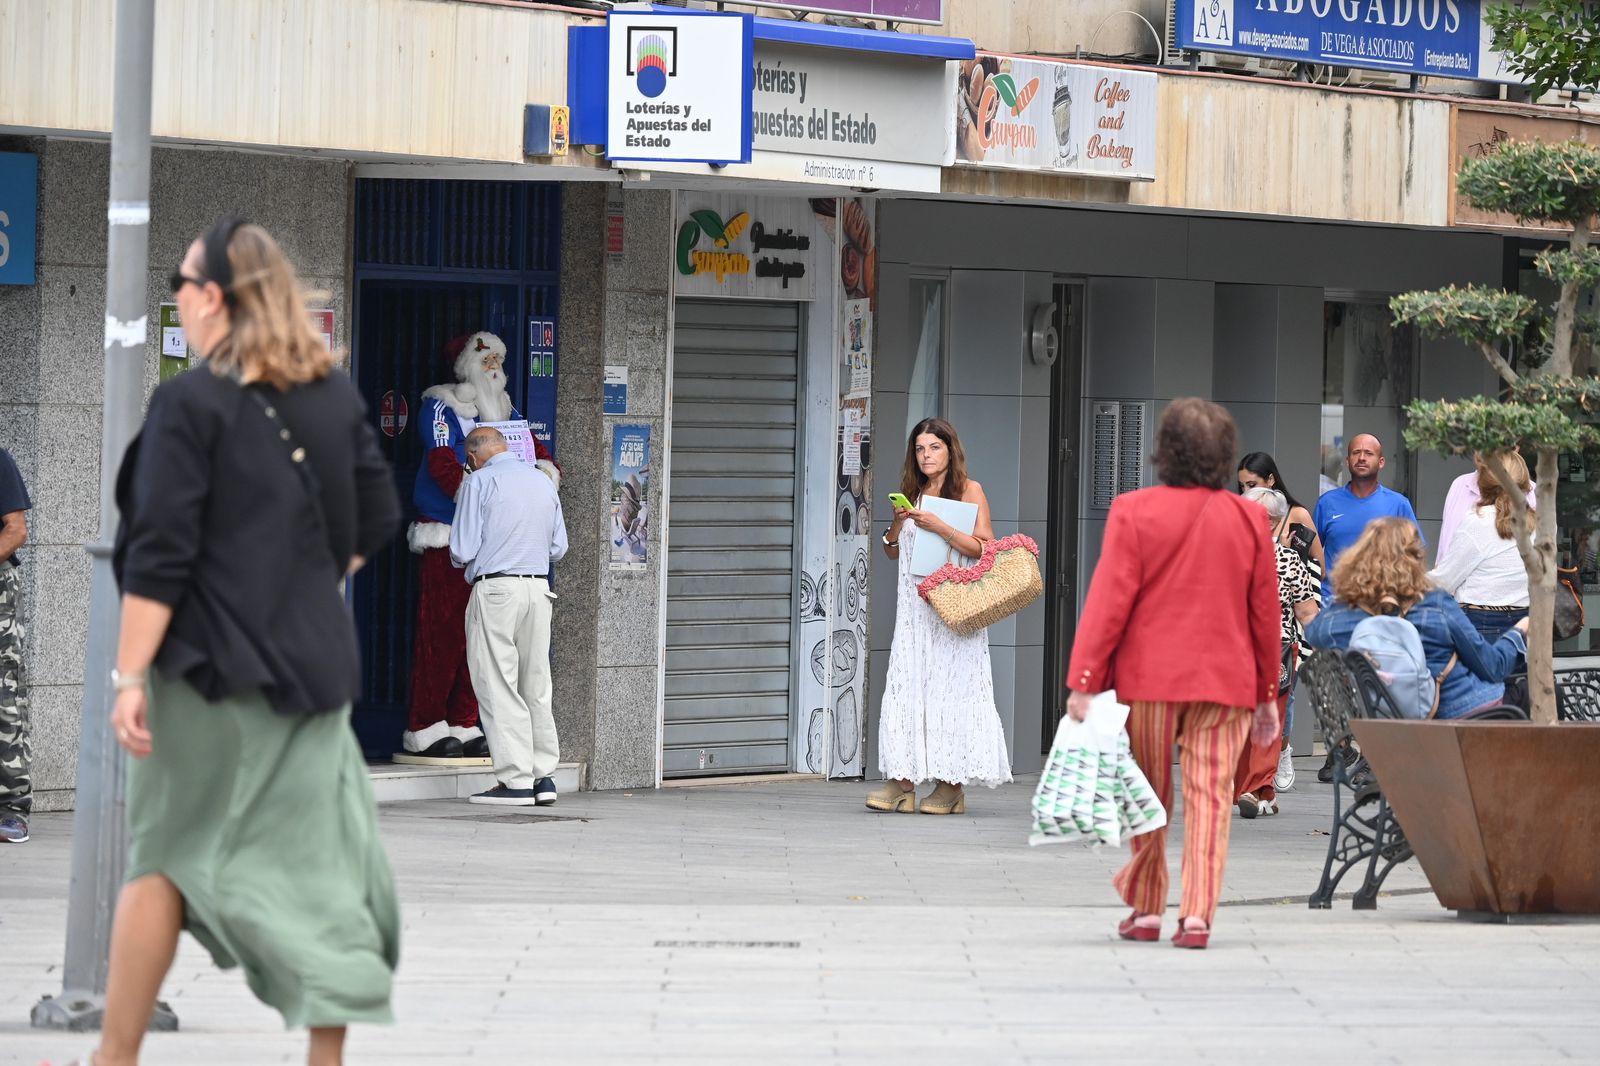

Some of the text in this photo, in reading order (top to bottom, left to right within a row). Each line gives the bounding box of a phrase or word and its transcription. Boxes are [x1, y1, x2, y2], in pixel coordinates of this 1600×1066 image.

[1196, 7, 1209, 38] A
[1216, 10, 1230, 41] A
[1255, 0, 1460, 33] GADOS
[1238, 28, 1310, 52] www.devega-asociados.com
[1321, 31, 1415, 60] DE VEGA & ASOCIADOS
[1424, 48, 1454, 70] (Entreplanta
[752, 61, 807, 104] oterías y
[1094, 77, 1130, 108] Coffee
[626, 101, 691, 118] Loterías y
[1098, 111, 1125, 130] and
[626, 118, 711, 133] Apuestas del
[752, 107, 876, 145] puestas del Estado
[625, 135, 671, 147] Estado
[1087, 134, 1133, 168] Bakery
[804, 161, 855, 180] Administración
[869, 167, 874, 182] 6
